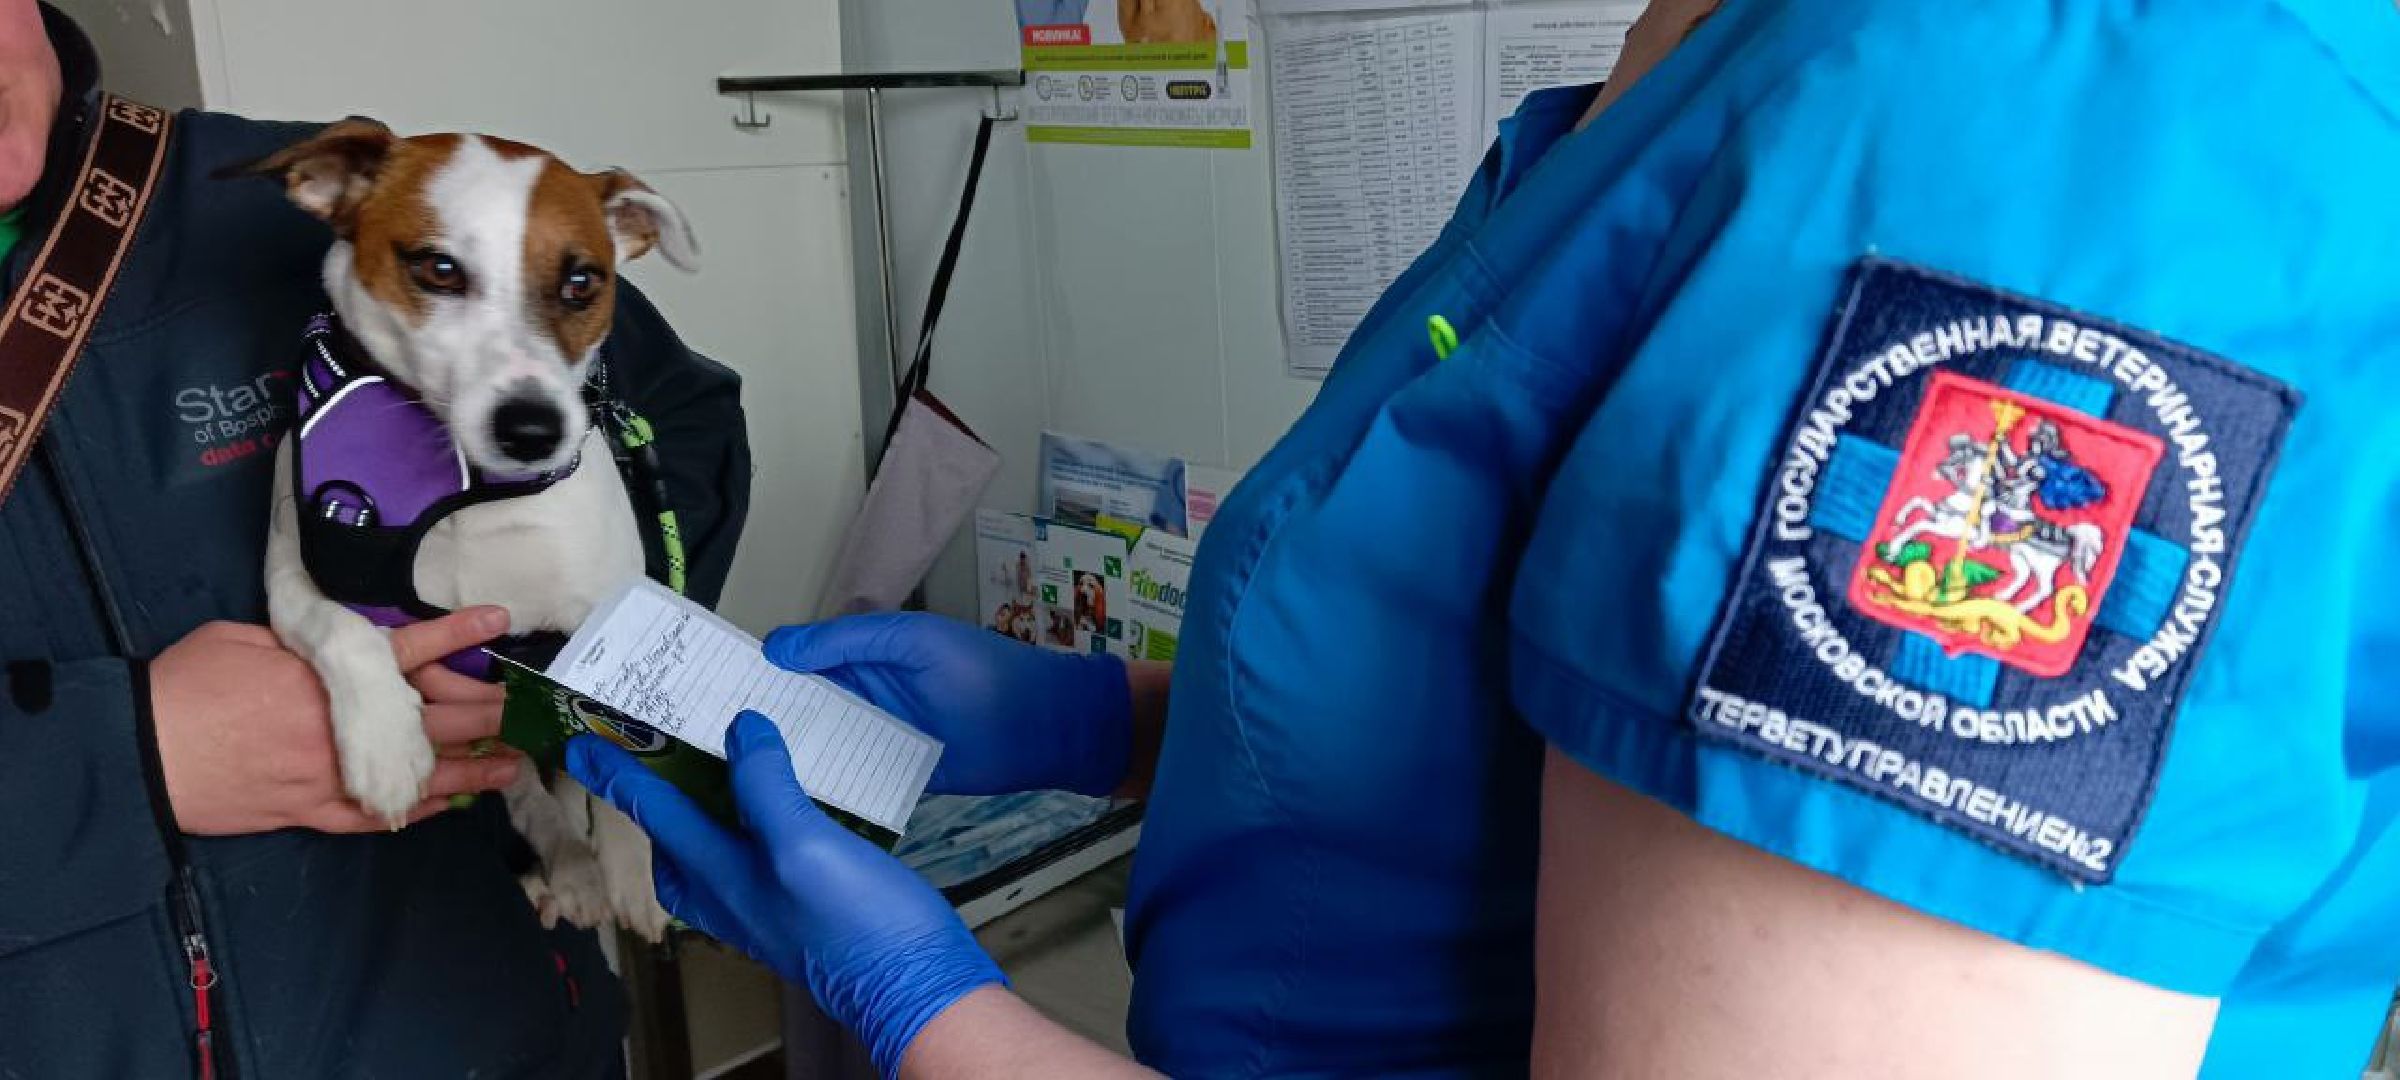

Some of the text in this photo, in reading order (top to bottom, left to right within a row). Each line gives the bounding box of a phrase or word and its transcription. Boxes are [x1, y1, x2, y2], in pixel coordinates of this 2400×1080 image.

[1776, 314, 2226, 691] ГОСУДАРСТВЕННАЯ ВЕТЕРИНАРНАЯ СЛУЖБА
[1767, 555, 2119, 745] МОСКОВСКОЙ ОБЛАСТИ
